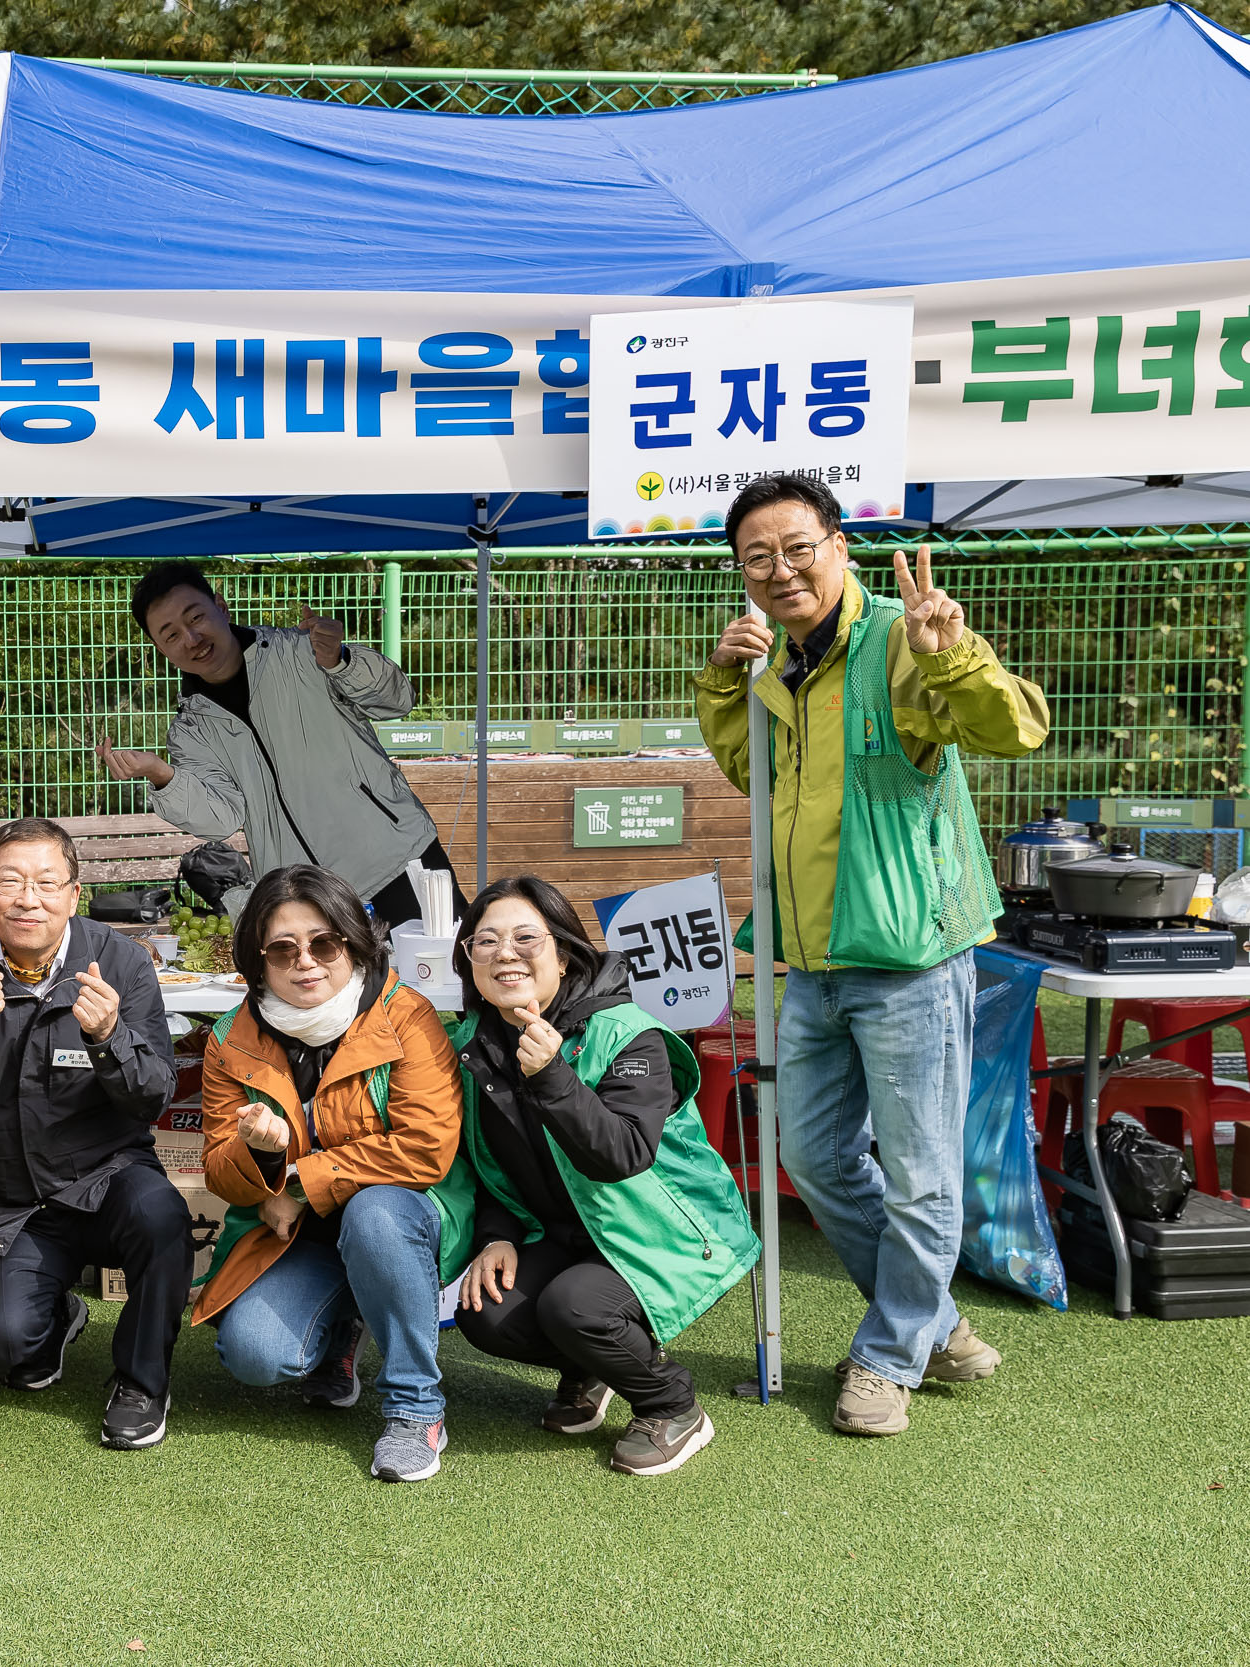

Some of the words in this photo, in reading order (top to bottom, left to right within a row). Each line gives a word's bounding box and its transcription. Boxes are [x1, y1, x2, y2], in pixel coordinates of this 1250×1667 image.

[651, 336, 689, 349] 광진구
[630, 359, 870, 450] 군자동
[391, 732, 431, 743] 일반쓰레기
[617, 907, 724, 982] 군자동
[681, 985, 711, 1000] 광진구
